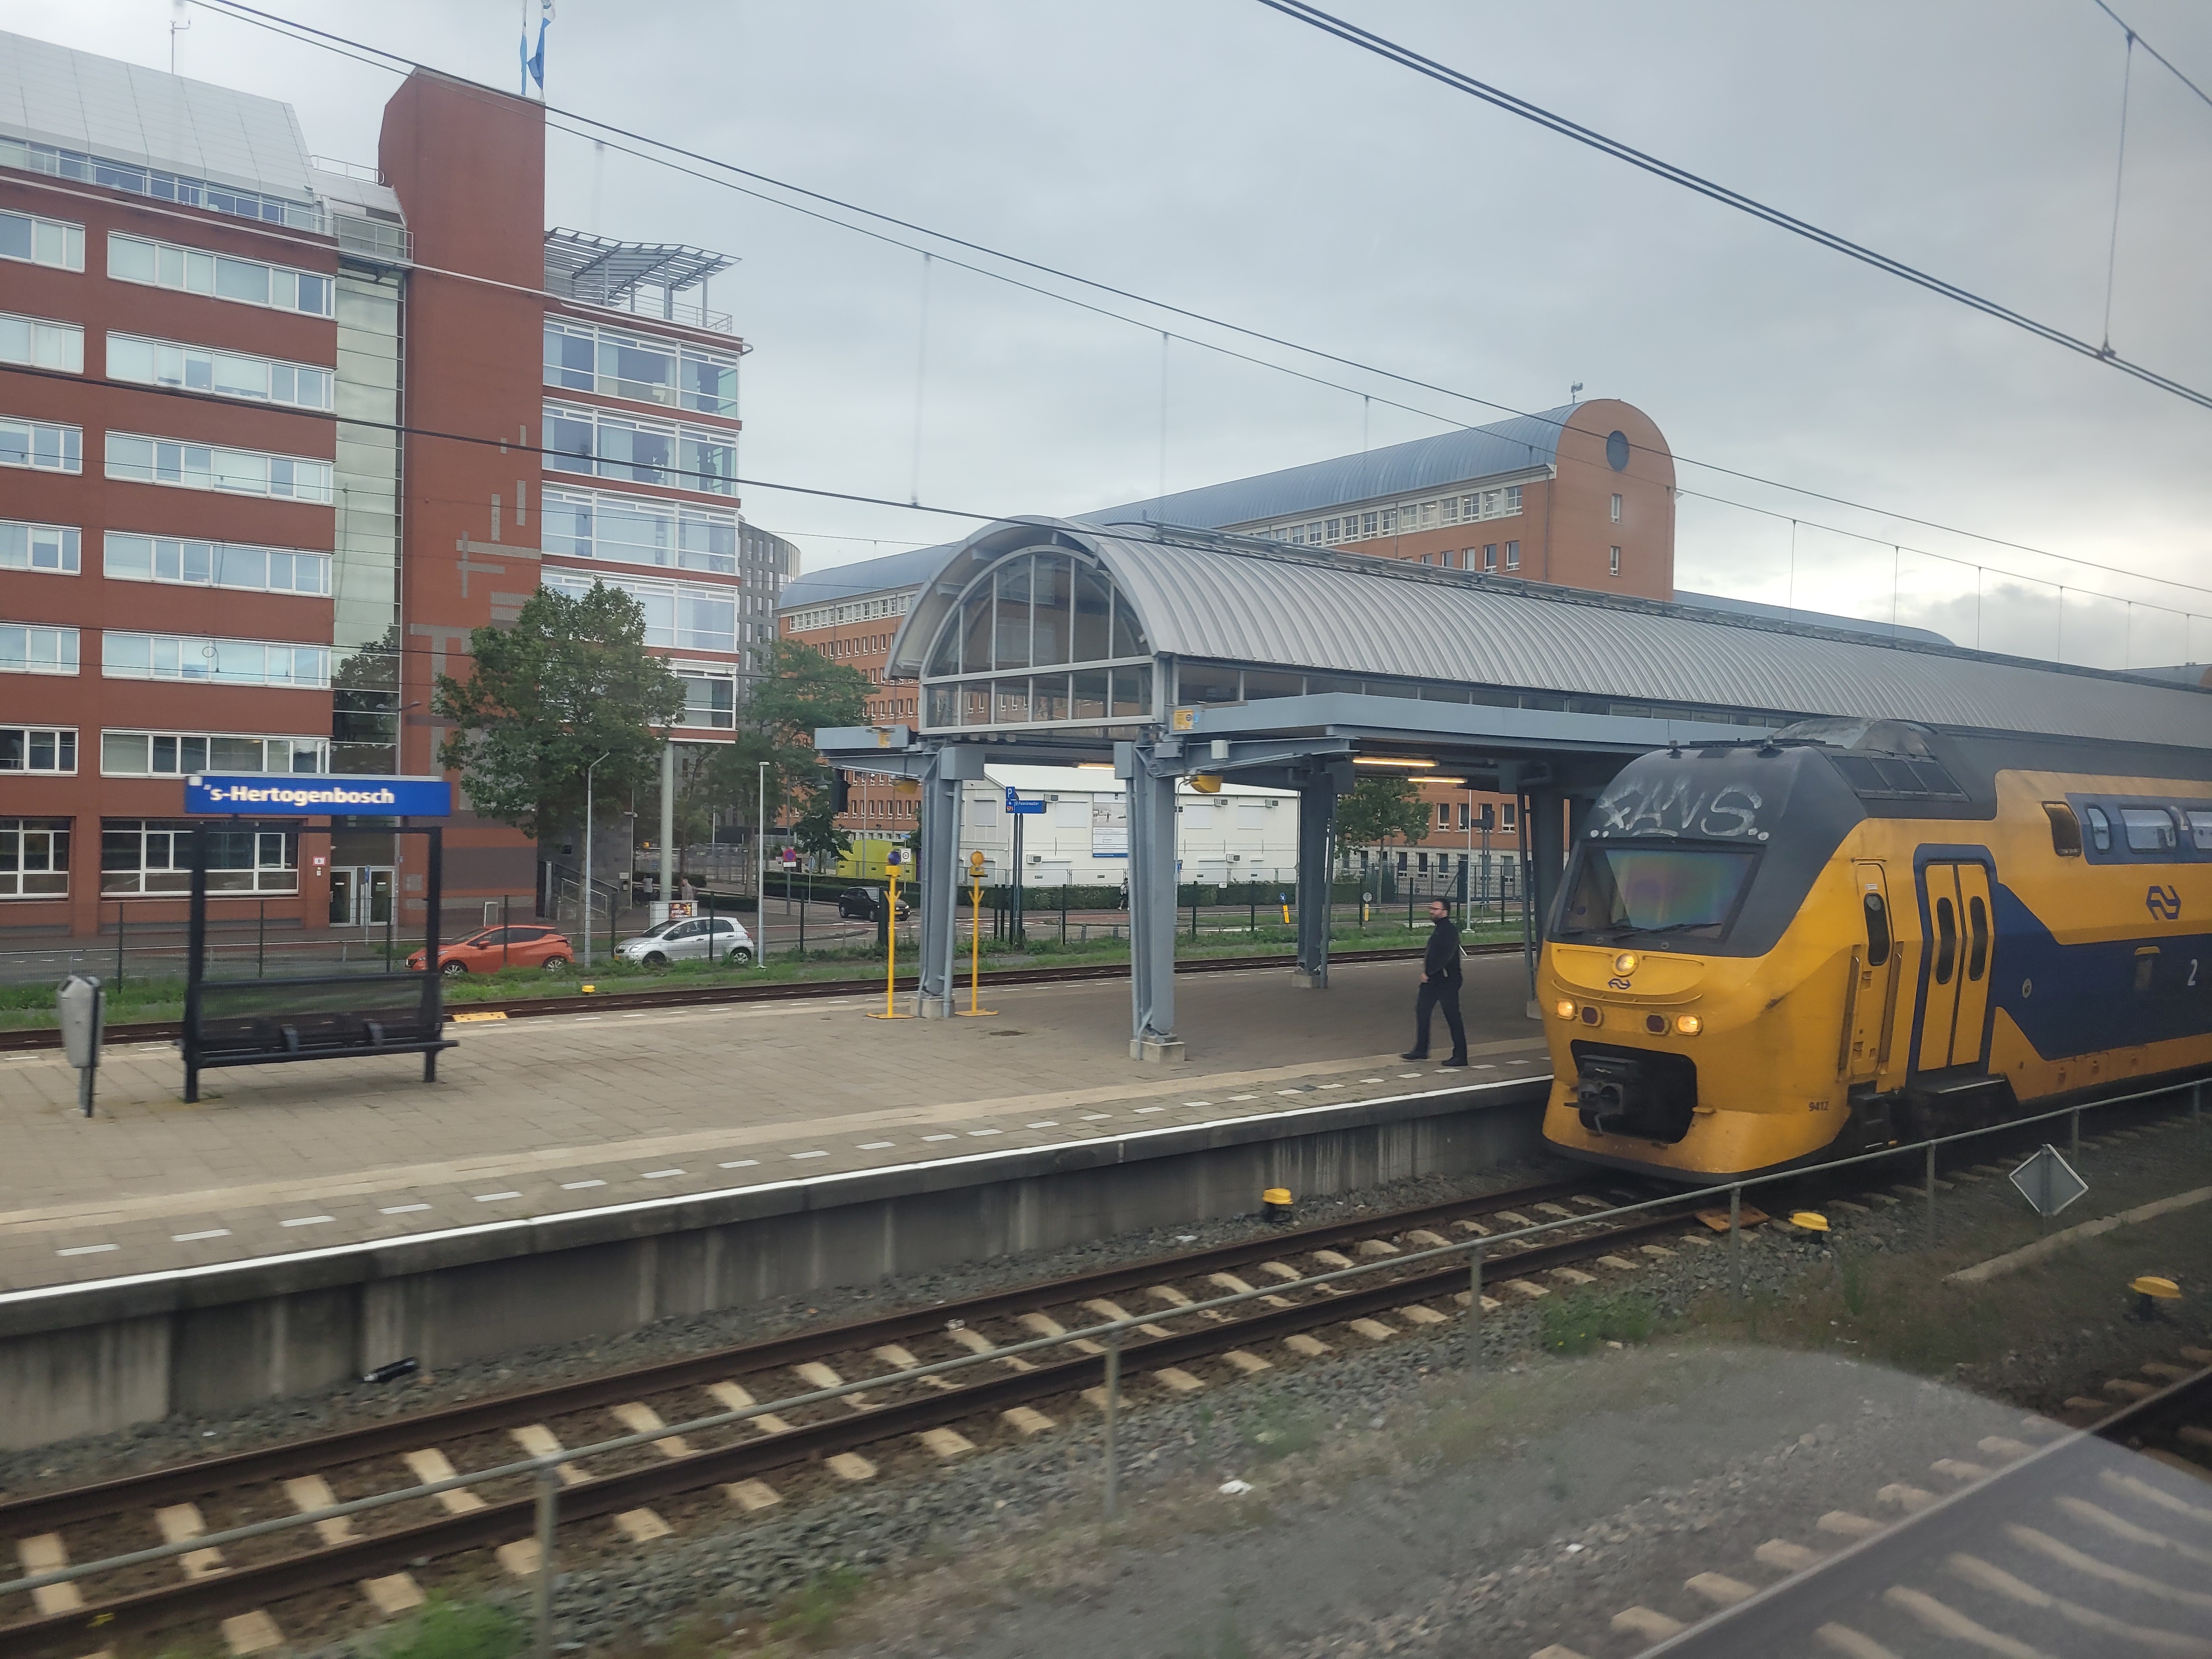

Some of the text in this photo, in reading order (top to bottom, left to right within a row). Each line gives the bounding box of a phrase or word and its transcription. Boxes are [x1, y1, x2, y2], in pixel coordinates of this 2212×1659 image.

[204, 784, 395, 806] 's-Hertogenbosch
[1007, 788, 1013, 798] P
[2170, 805, 2189, 831] 2
[2187, 958, 2198, 986] 2
[1809, 1101, 1829, 1112] 9412
